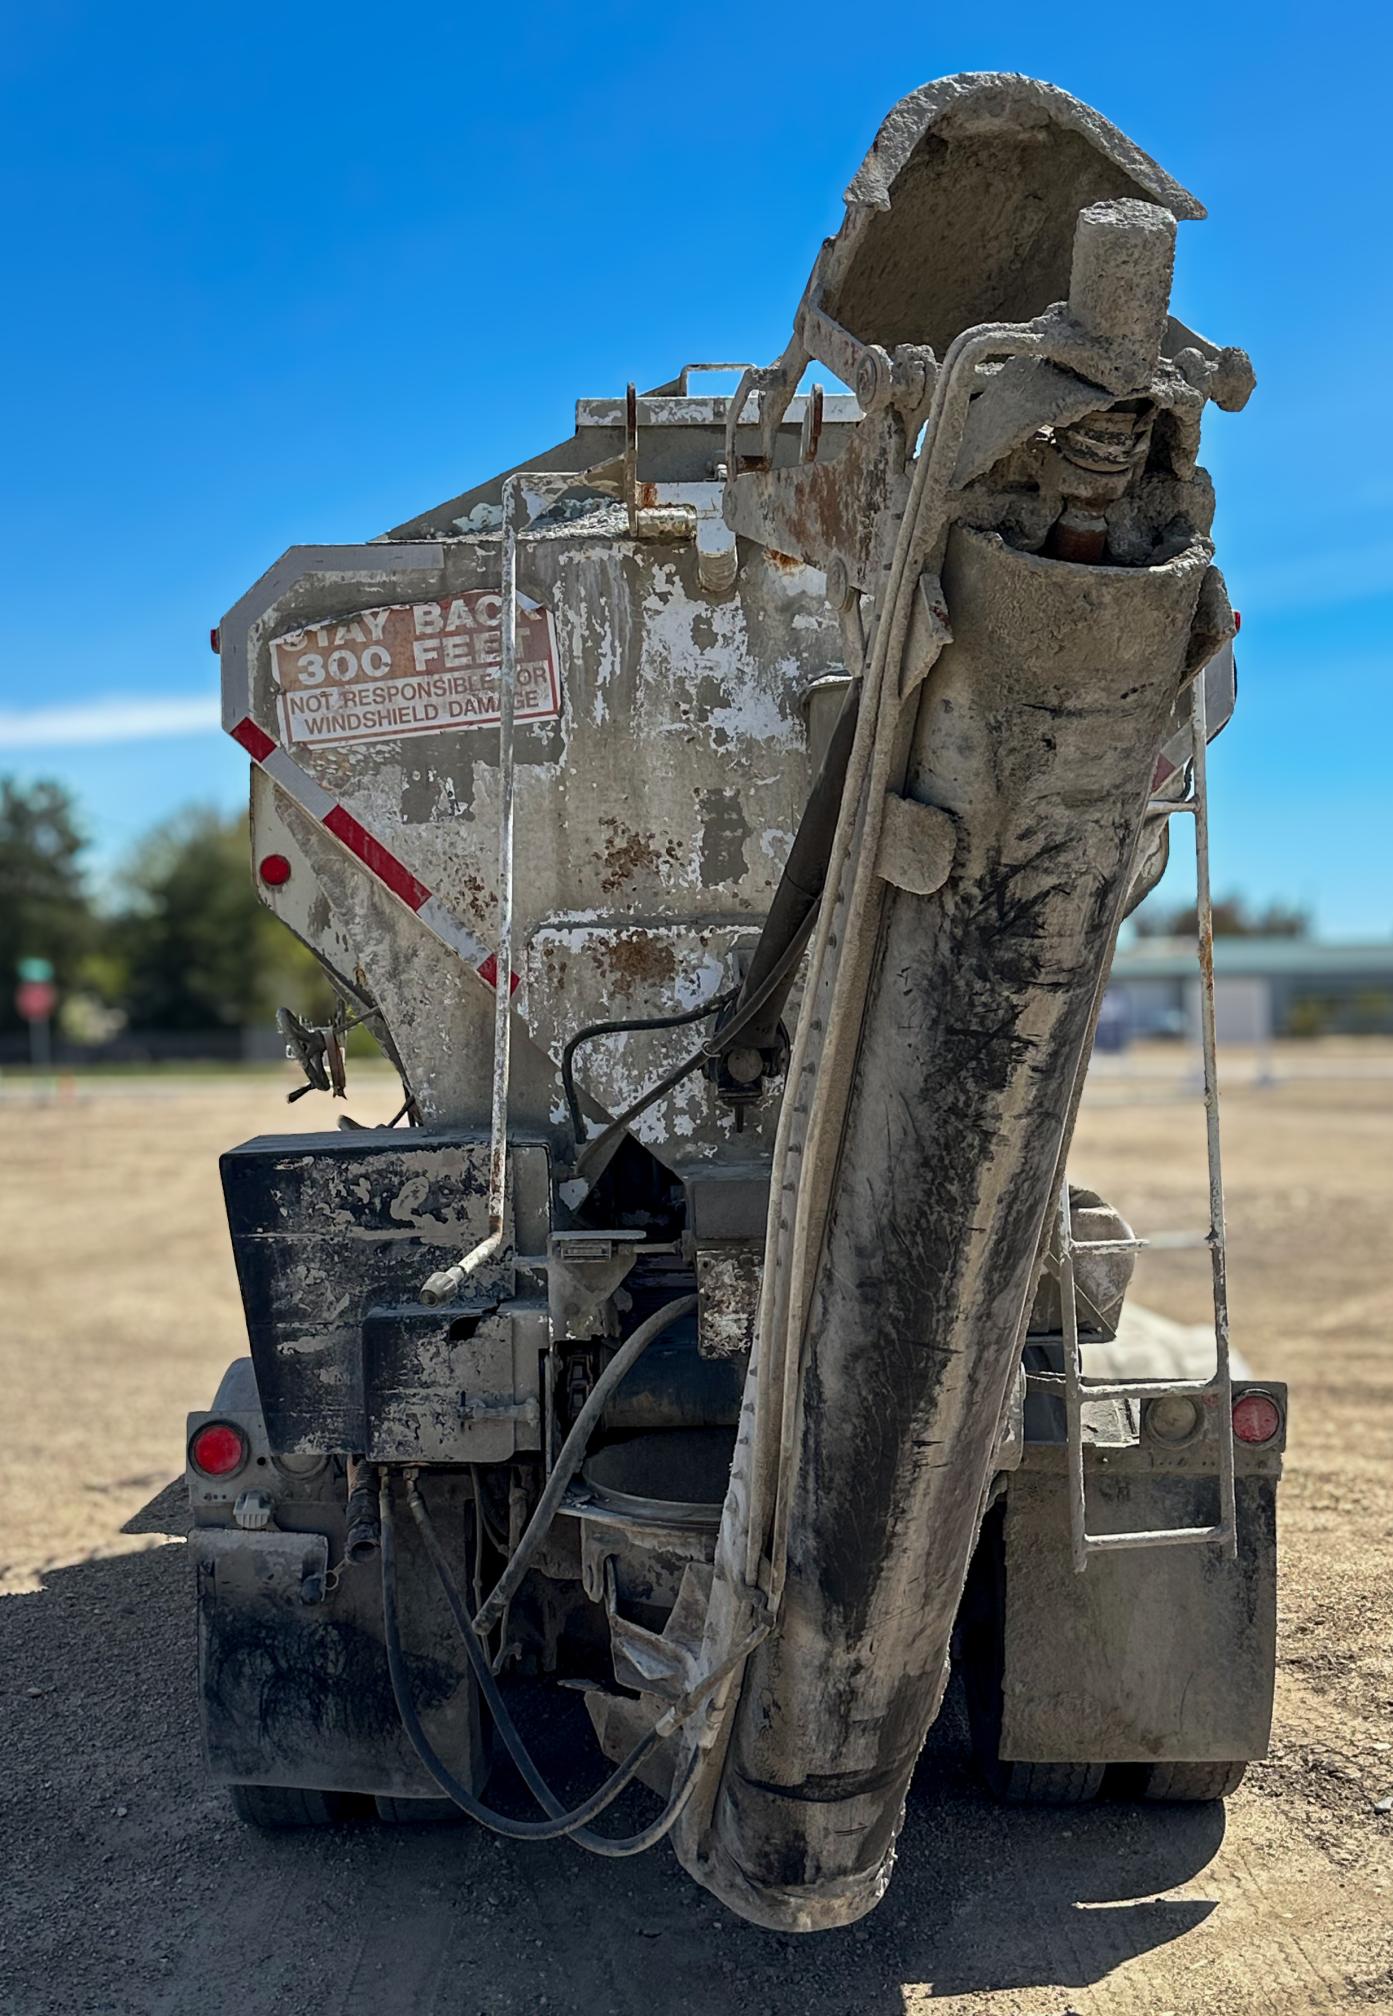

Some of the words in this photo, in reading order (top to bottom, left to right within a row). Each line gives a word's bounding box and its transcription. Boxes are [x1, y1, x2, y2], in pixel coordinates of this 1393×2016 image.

[297, 645, 392, 685] 300
[289, 692, 334, 715] NOT
[342, 673, 495, 709] RESPONSIBLE
[514, 667, 547, 686] OR
[304, 704, 439, 735] WINDSHIELD
[449, 690, 539, 718] DAMGE
